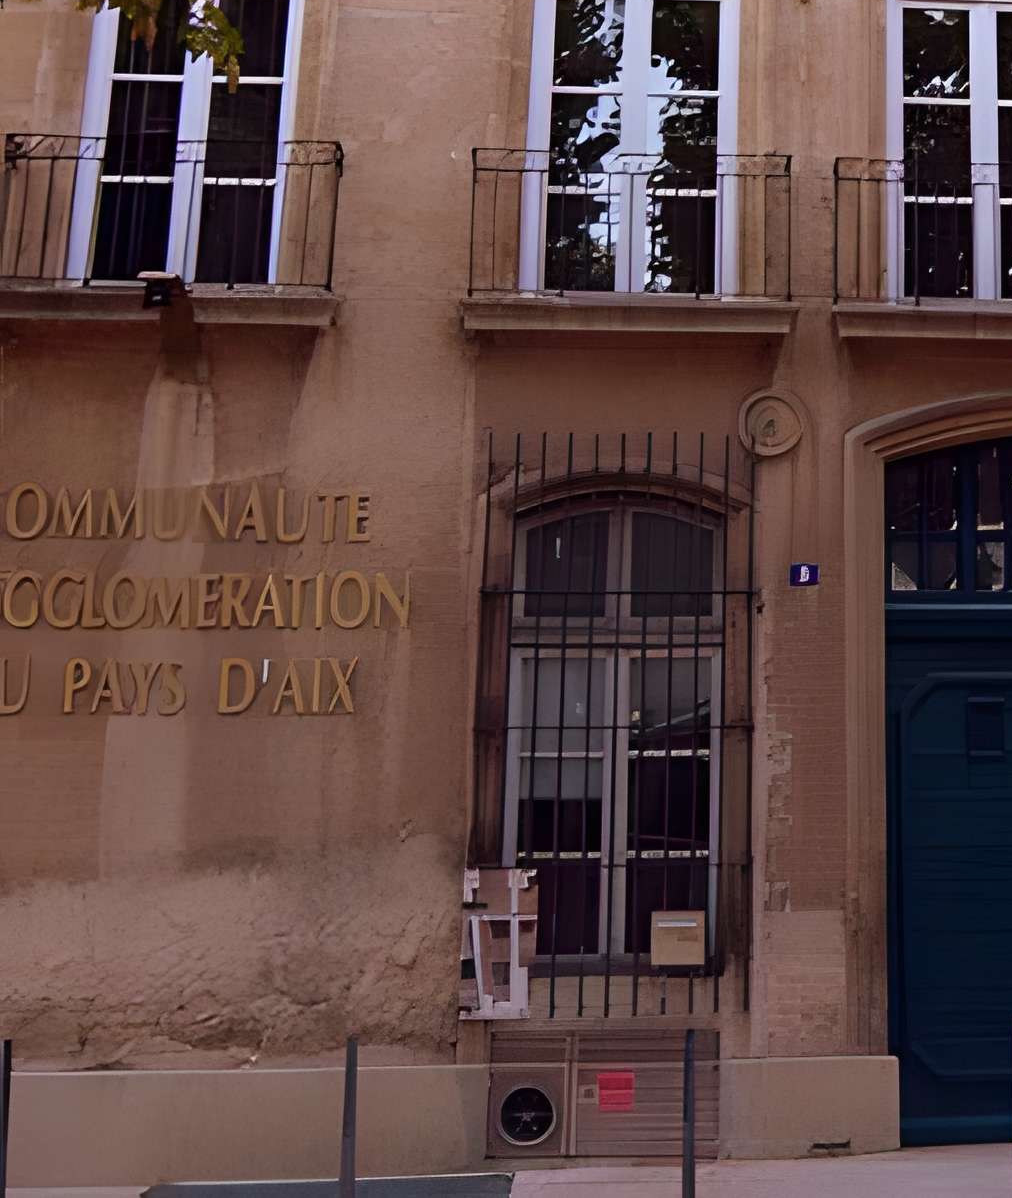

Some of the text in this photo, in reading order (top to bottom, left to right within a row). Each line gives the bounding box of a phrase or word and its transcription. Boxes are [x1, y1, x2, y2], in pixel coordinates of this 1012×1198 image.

[0, 569, 411, 630] GGLOMERATION
[63, 657, 187, 716] PAYS
[217, 655, 360, 716] D'AIX
